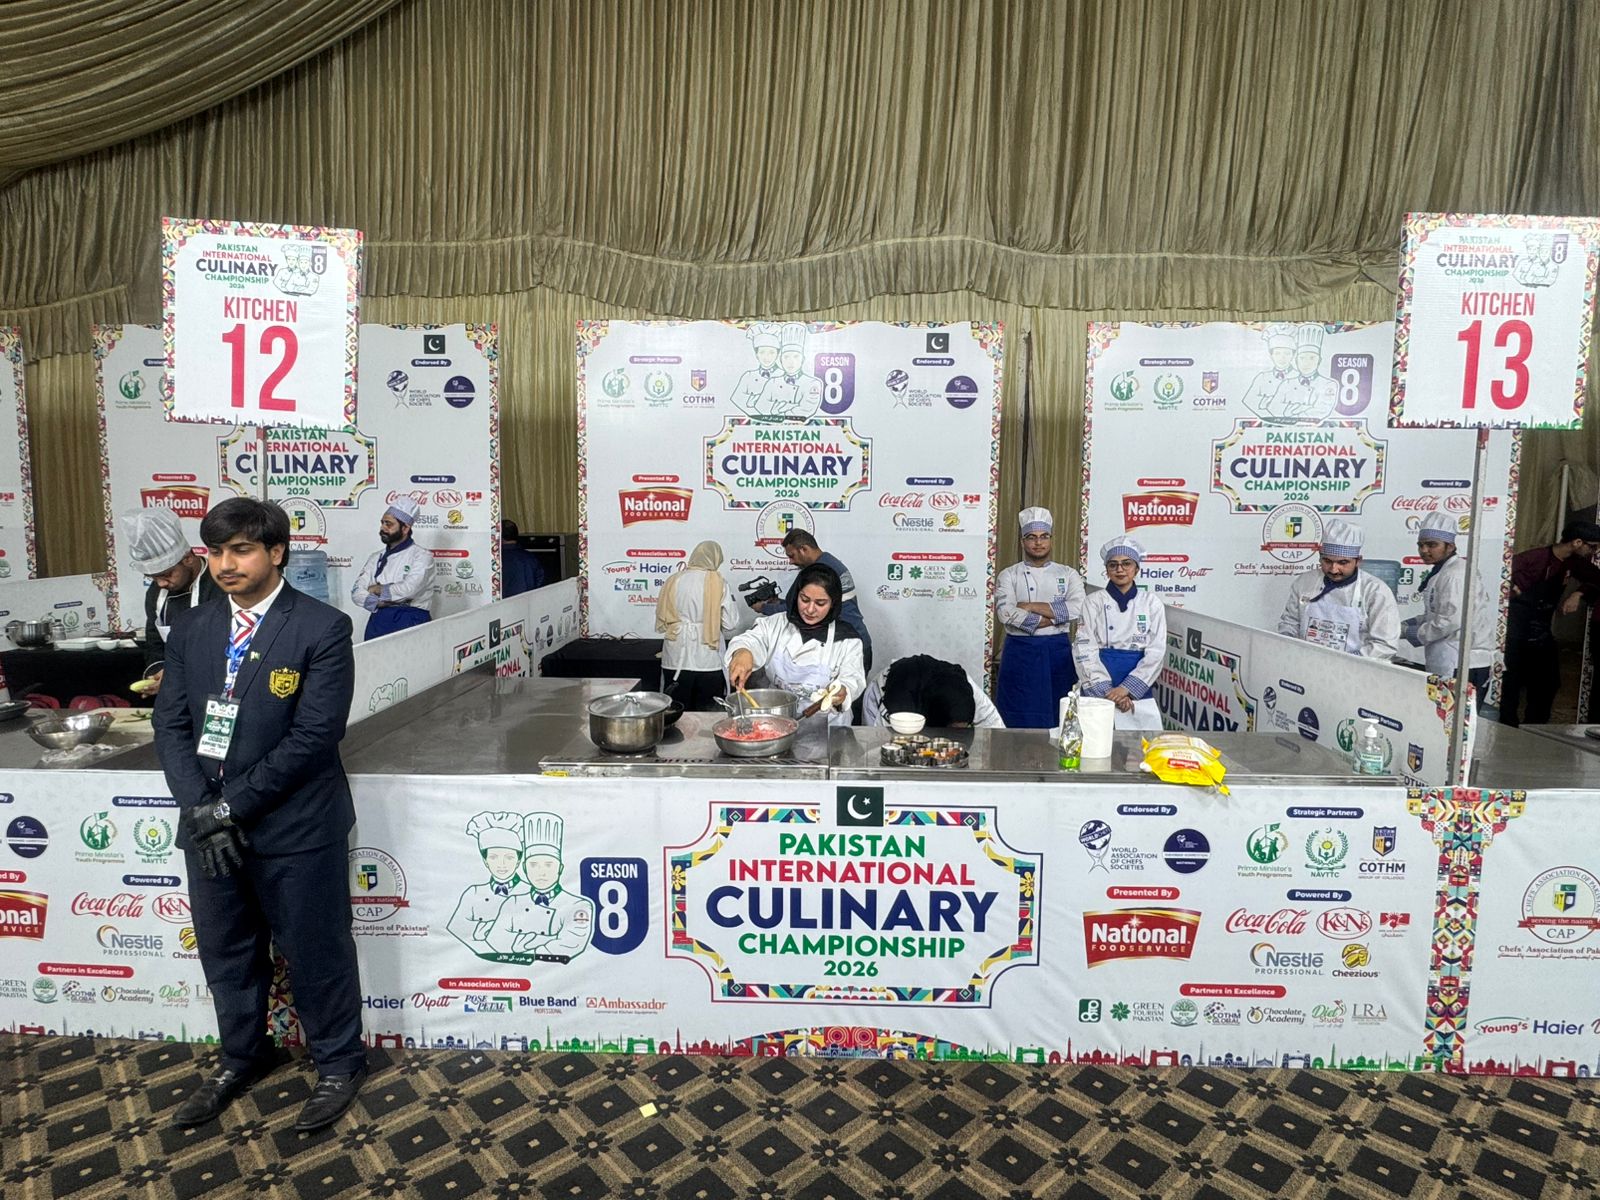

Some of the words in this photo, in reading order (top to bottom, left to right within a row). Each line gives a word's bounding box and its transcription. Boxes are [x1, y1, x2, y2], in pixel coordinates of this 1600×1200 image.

[216, 243, 258, 253] PAKISTAN
[1554, 243, 1565, 261] 8
[202, 251, 272, 262] INTERNATIONAL
[1436, 253, 1520, 269] CULINARY
[196, 258, 279, 277] CULINARY
[313, 257, 325, 274] 8
[1444, 268, 1510, 276] CHAMPIONSHIP
[205, 273, 270, 284] CHAMPIONSHIP
[223, 296, 298, 323] KITCHEN
[1461, 292, 1535, 316] KITCHEN
[222, 323, 299, 411] 12
[820, 357, 849, 366] SEASON
[1337, 357, 1368, 368] SEASON
[1457, 319, 1534, 411] 13
[824, 367, 843, 405] 8
[1340, 369, 1360, 406] 8
[683, 395, 715, 404] COTHM
[1192, 398, 1226, 407] COTHM
[267, 429, 327, 440] PAKISTAN
[755, 430, 821, 441] PAKISTAN
[1266, 432, 1334, 444] PAKISTAN
[245, 442, 349, 453] INERNATIONAL
[732, 443, 843, 454] INTERNATIONAL
[1241, 444, 1356, 456] INTERNATIONAL
[722, 455, 853, 476] CULINARY
[1230, 458, 1367, 479] CULINARY
[250, 476, 347, 486] CAMPIONSHIP
[736, 477, 839, 488] CHAMPIONSHIP
[1244, 480, 1351, 491] CHAMPIONSHIP
[774, 489, 800, 498] 2026
[1283, 492, 1310, 501] 2026
[146, 495, 203, 509] National
[624, 497, 685, 512] National
[878, 492, 926, 508] Coca-Cola
[1391, 495, 1440, 511] Coca-Cola
[1127, 501, 1190, 516] National
[291, 543, 309, 551] CAP
[1281, 550, 1303, 559] CAP
[606, 564, 637, 574] Young's
[640, 563, 672, 574] Haier
[1140, 568, 1174, 579] Haier
[1155, 584, 1173, 592] Blue
[1174, 584, 1196, 592] Band
[1169, 653, 1215, 685] PAKISTAN
[118, 798, 147, 806] Strategic
[148, 798, 176, 806] Partners
[1161, 806, 1172, 814] By
[1293, 808, 1325, 817] Strategic
[1326, 809, 1357, 817] Partners
[779, 833, 925, 858] PAKISTAN
[590, 863, 638, 878] SEASON
[729, 859, 975, 886] INTERNATIONAL
[1359, 862, 1406, 873] COTHM
[9, 872, 20, 881] By
[1113, 888, 1159, 897] Presented
[1161, 889, 1172, 898] By
[1332, 892, 1343, 900] By
[71, 891, 147, 918] Coca-Cola
[598, 880, 629, 939] 8
[705, 885, 999, 933] CULINARY
[356, 907, 383, 917] CAP
[1225, 907, 1311, 935] Coca-Cola
[1323, 912, 1368, 932] K&N's
[1091, 922, 1189, 945] National
[1546, 928, 1576, 939] CAP
[112, 934, 163, 949] Nestlé
[738, 933, 965, 958] CHAMPIONSHIP
[1091, 944, 1186, 953] FOODSERVICE
[173, 951, 200, 960] Cheezi
[1266, 951, 1324, 968] Nestlé
[47, 966, 77, 974] Partners
[78, 966, 86, 974] in
[87, 967, 124, 976] Excellence
[823, 961, 879, 977] 2026
[1255, 968, 1323, 976] PROFESSIONAL
[1332, 969, 1379, 978] Cheezious
[502, 981, 520, 989] With
[116, 987, 150, 995] Chocolate
[1234, 988, 1276, 996] Excellence
[118, 994, 153, 1004] Academy
[361, 995, 405, 1009] Haier
[411, 992, 459, 1012] Dipitt
[519, 996, 545, 1007] Blue
[547, 996, 577, 1007] Band
[598, 997, 668, 1009] Ambassador
[1133, 1002, 1164, 1010] GREEN
[1263, 1007, 1302, 1016] Chocolate
[1312, 1004, 1339, 1018] Diet
[1352, 1003, 1387, 1018] LRA
[1265, 1015, 1305, 1024] Academy
[1480, 1021, 1529, 1034] Young's
[1533, 1020, 1584, 1035] Haier
